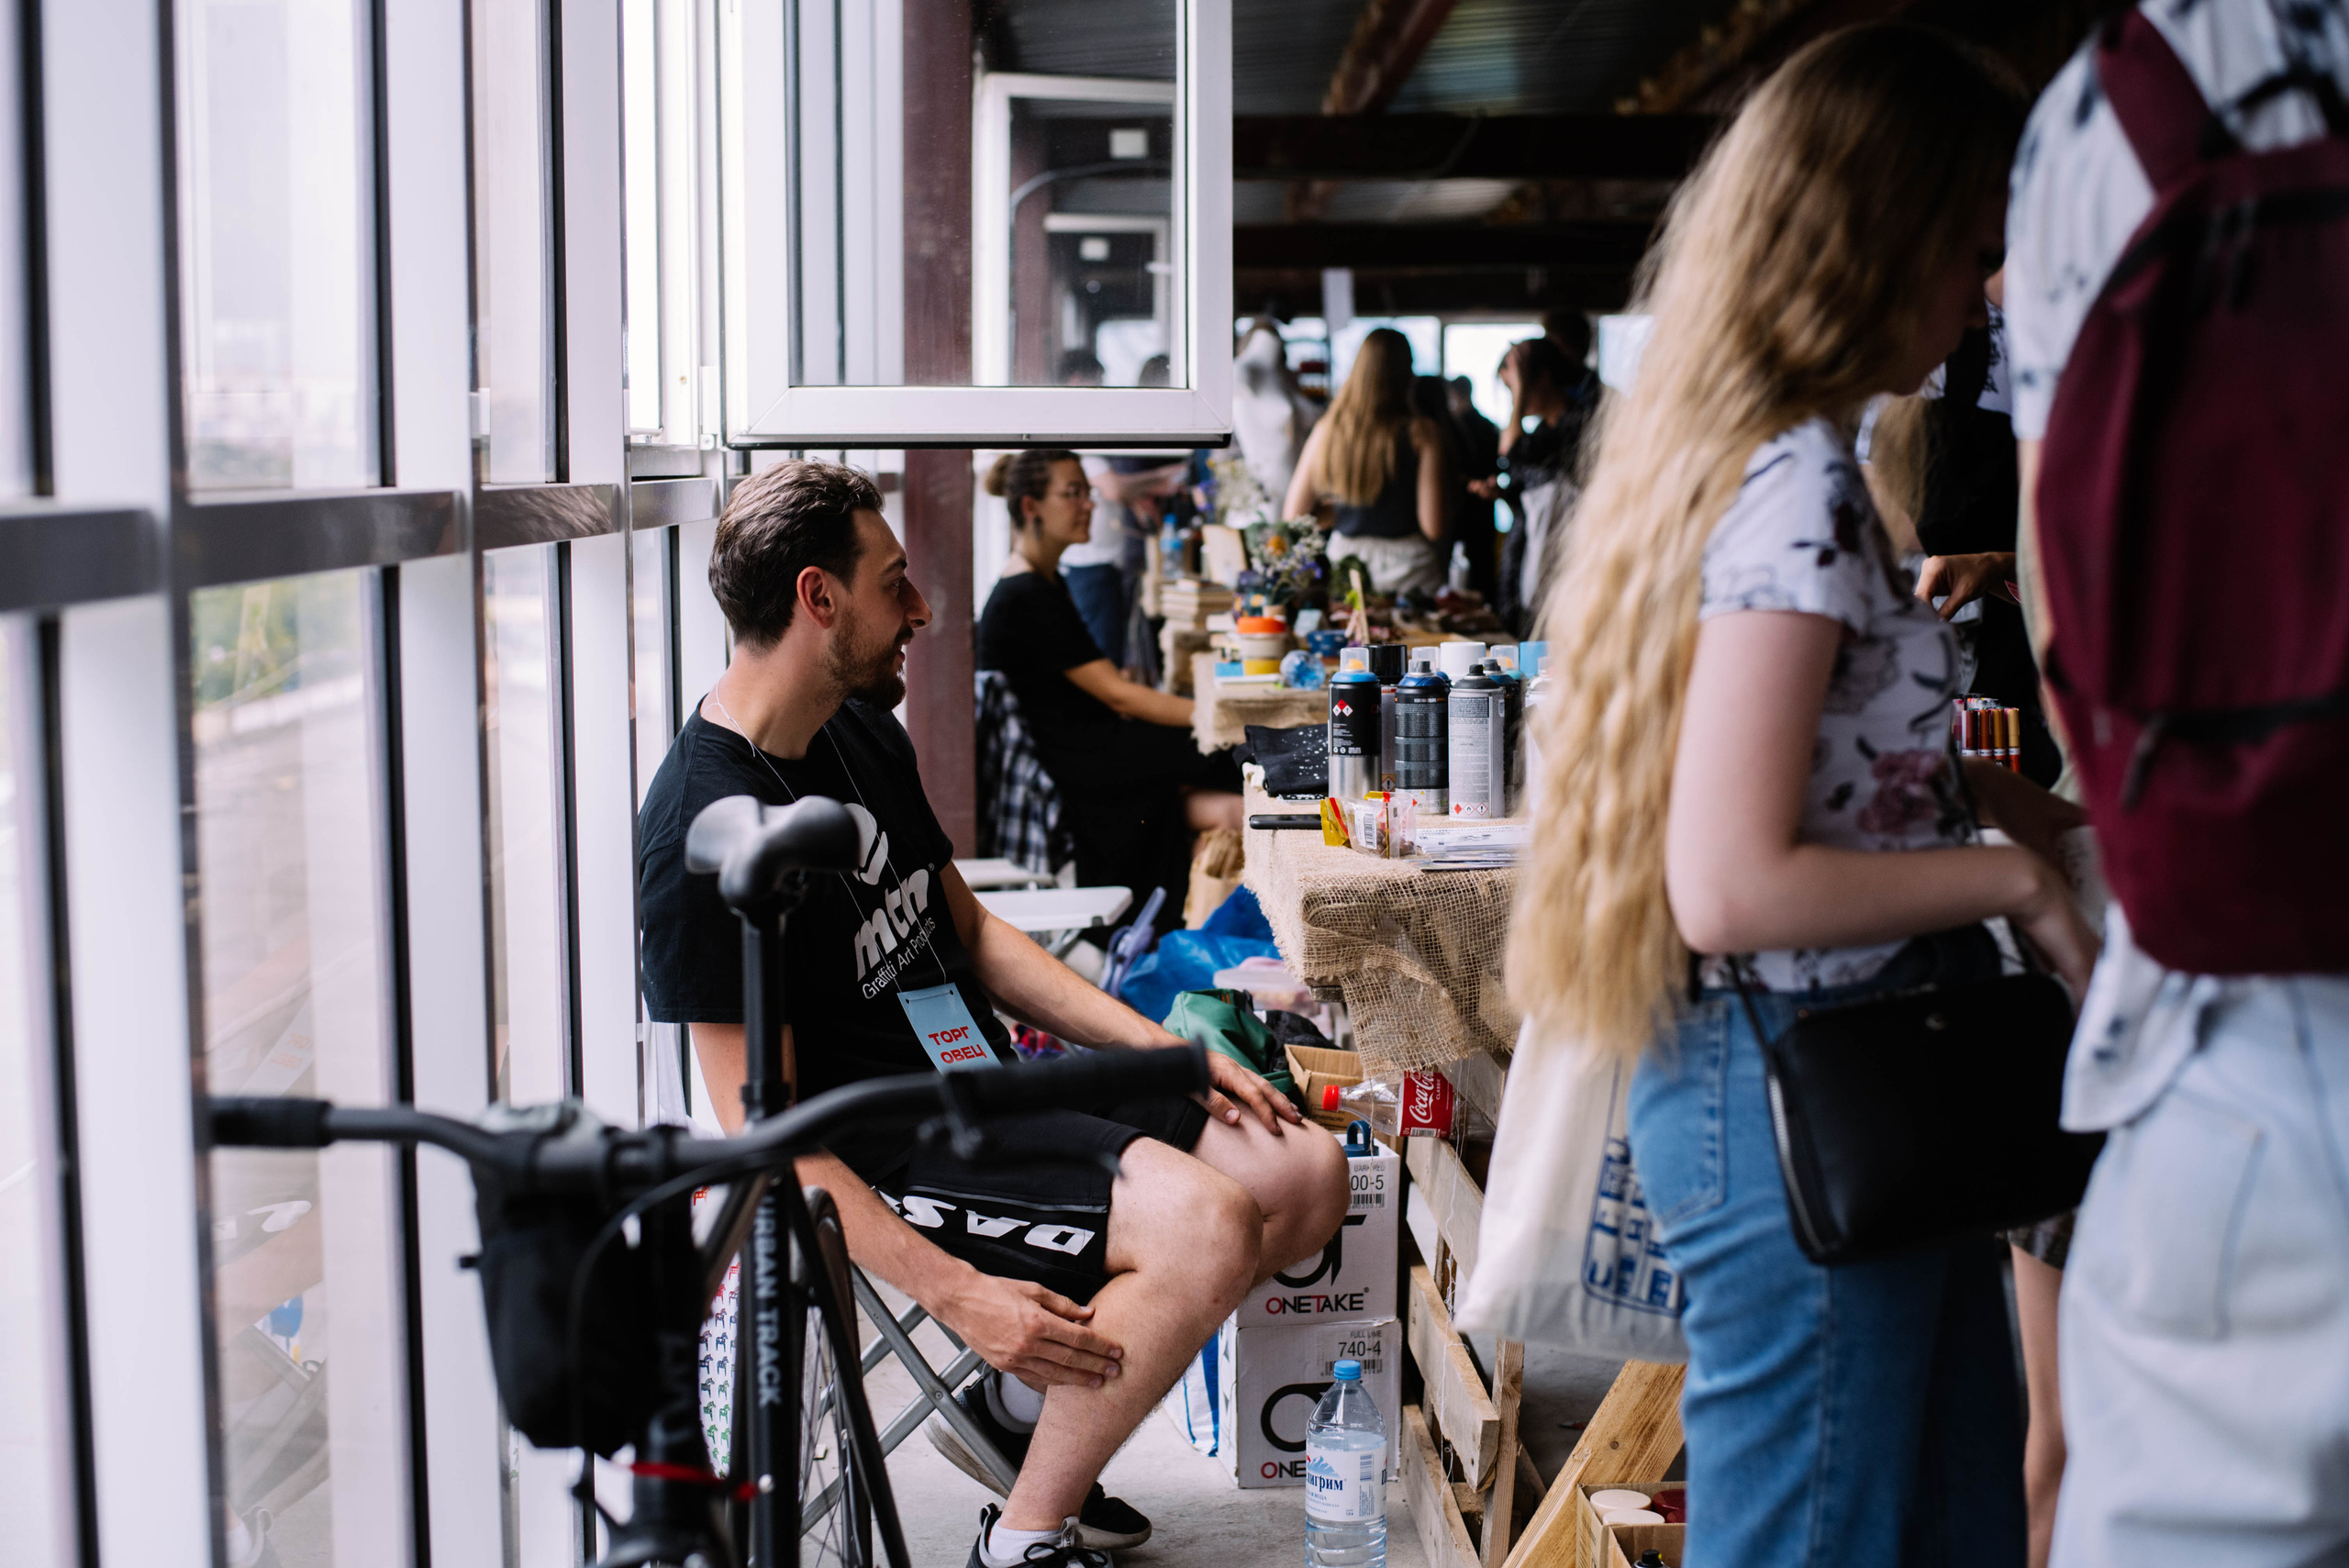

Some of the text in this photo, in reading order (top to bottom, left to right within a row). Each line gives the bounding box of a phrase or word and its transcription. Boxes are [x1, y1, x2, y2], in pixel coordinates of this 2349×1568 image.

[854, 868, 930, 983] mtn
[862, 917, 937, 1000] Graffiti Art Products
[928, 1026, 970, 1046] ТОРГ
[940, 1044, 988, 1064] ОВЕЦ
[1408, 1070, 1435, 1124] Coca-Co
[1350, 1174, 1384, 1191] 00-5
[878, 1190, 1097, 1257] DAS
[753, 1195, 783, 1409] URBAN TRACK
[1265, 1293, 1364, 1315] ONETAKE
[1338, 1340, 1382, 1357] 740-4
[1306, 1472, 1343, 1493] лигрим
